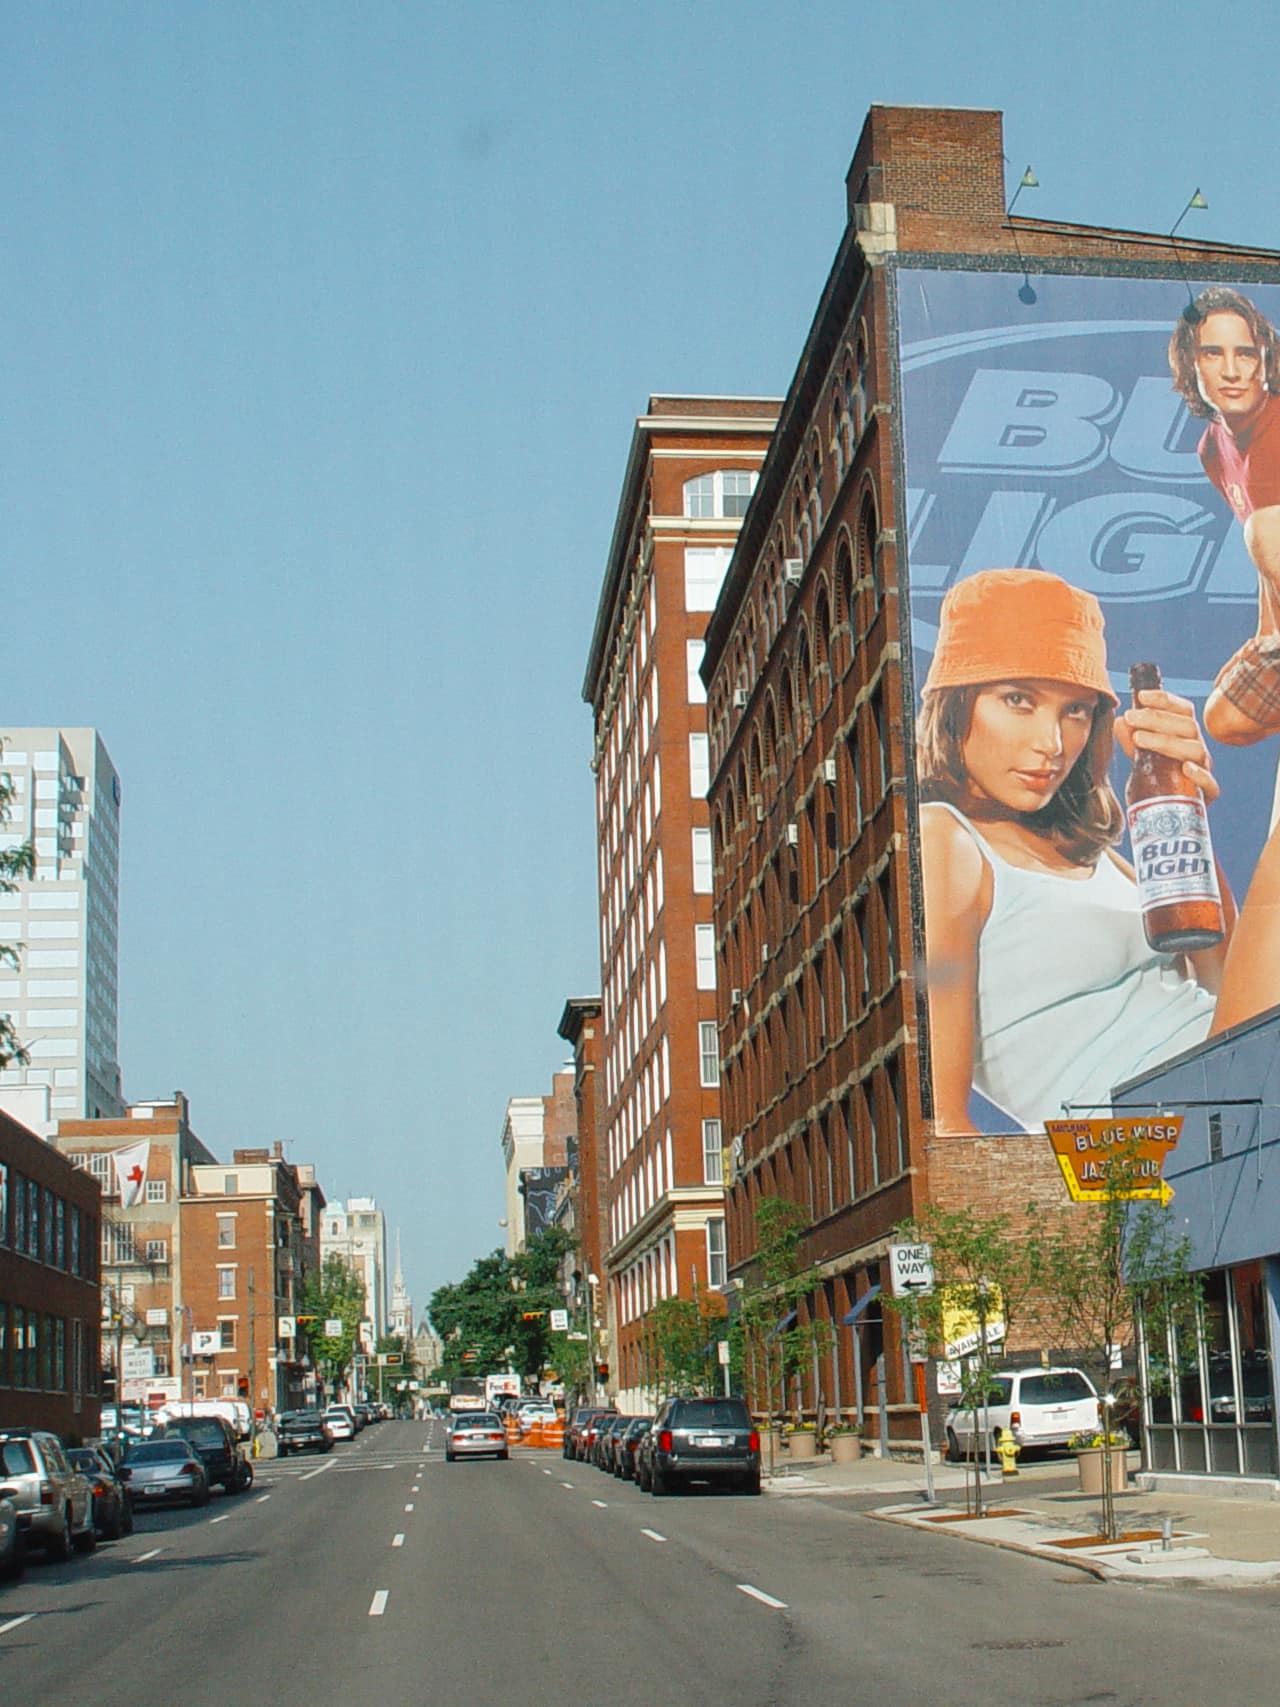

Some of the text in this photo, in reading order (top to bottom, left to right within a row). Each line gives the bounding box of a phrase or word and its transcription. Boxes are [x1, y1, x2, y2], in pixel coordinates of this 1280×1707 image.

[1141, 839, 1203, 862] BUD
[1139, 858, 1212, 883] LIGHT
[1075, 1126, 1126, 1151] BLUE
[1128, 1124, 1178, 1143] WISP
[897, 1249, 925, 1260] ONE
[897, 1263, 926, 1275] WAY
[949, 1325, 1001, 1356] AVAILLE
